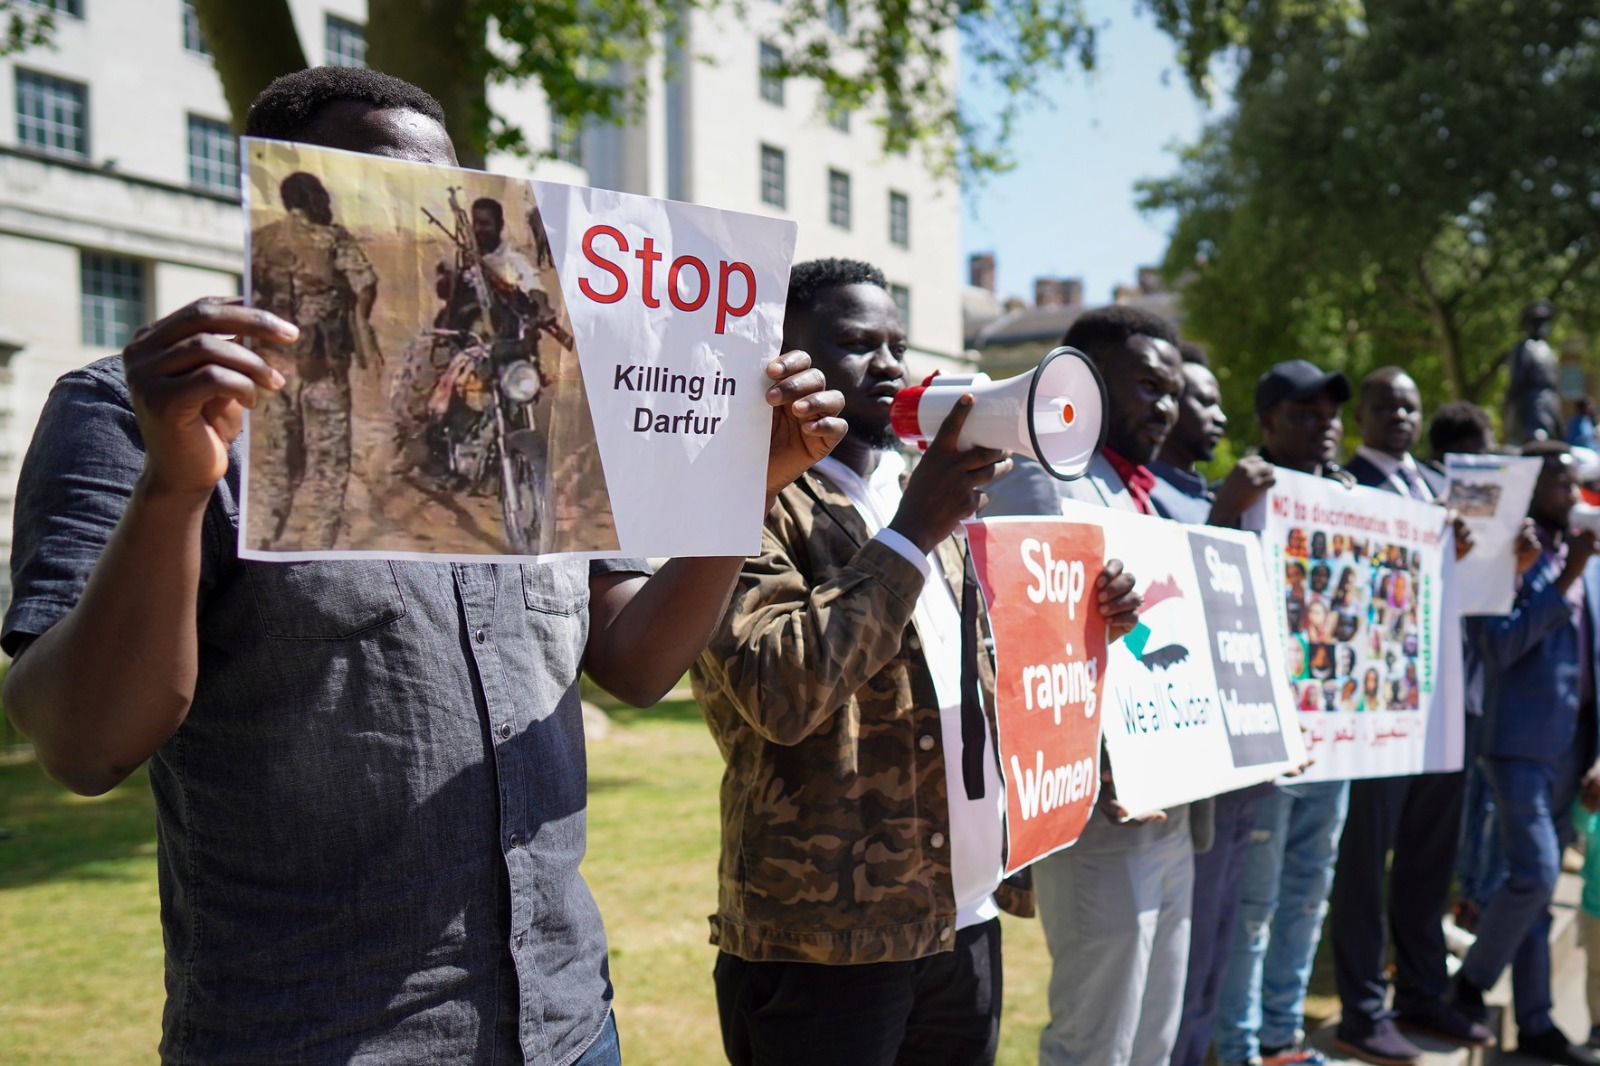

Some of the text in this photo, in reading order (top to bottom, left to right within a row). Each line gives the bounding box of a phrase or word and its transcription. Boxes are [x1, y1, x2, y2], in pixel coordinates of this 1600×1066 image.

[578, 224, 757, 335] Stop
[613, 364, 736, 401] Killing in
[633, 407, 721, 435] Darfur
[1020, 537, 1084, 620] Stop
[1204, 545, 1244, 607] Stop
[1217, 619, 1266, 677] raping
[1022, 643, 1098, 725] raping
[1115, 682, 1215, 735] We all Sudan
[1219, 688, 1280, 736] Women
[1010, 750, 1093, 821] Women
